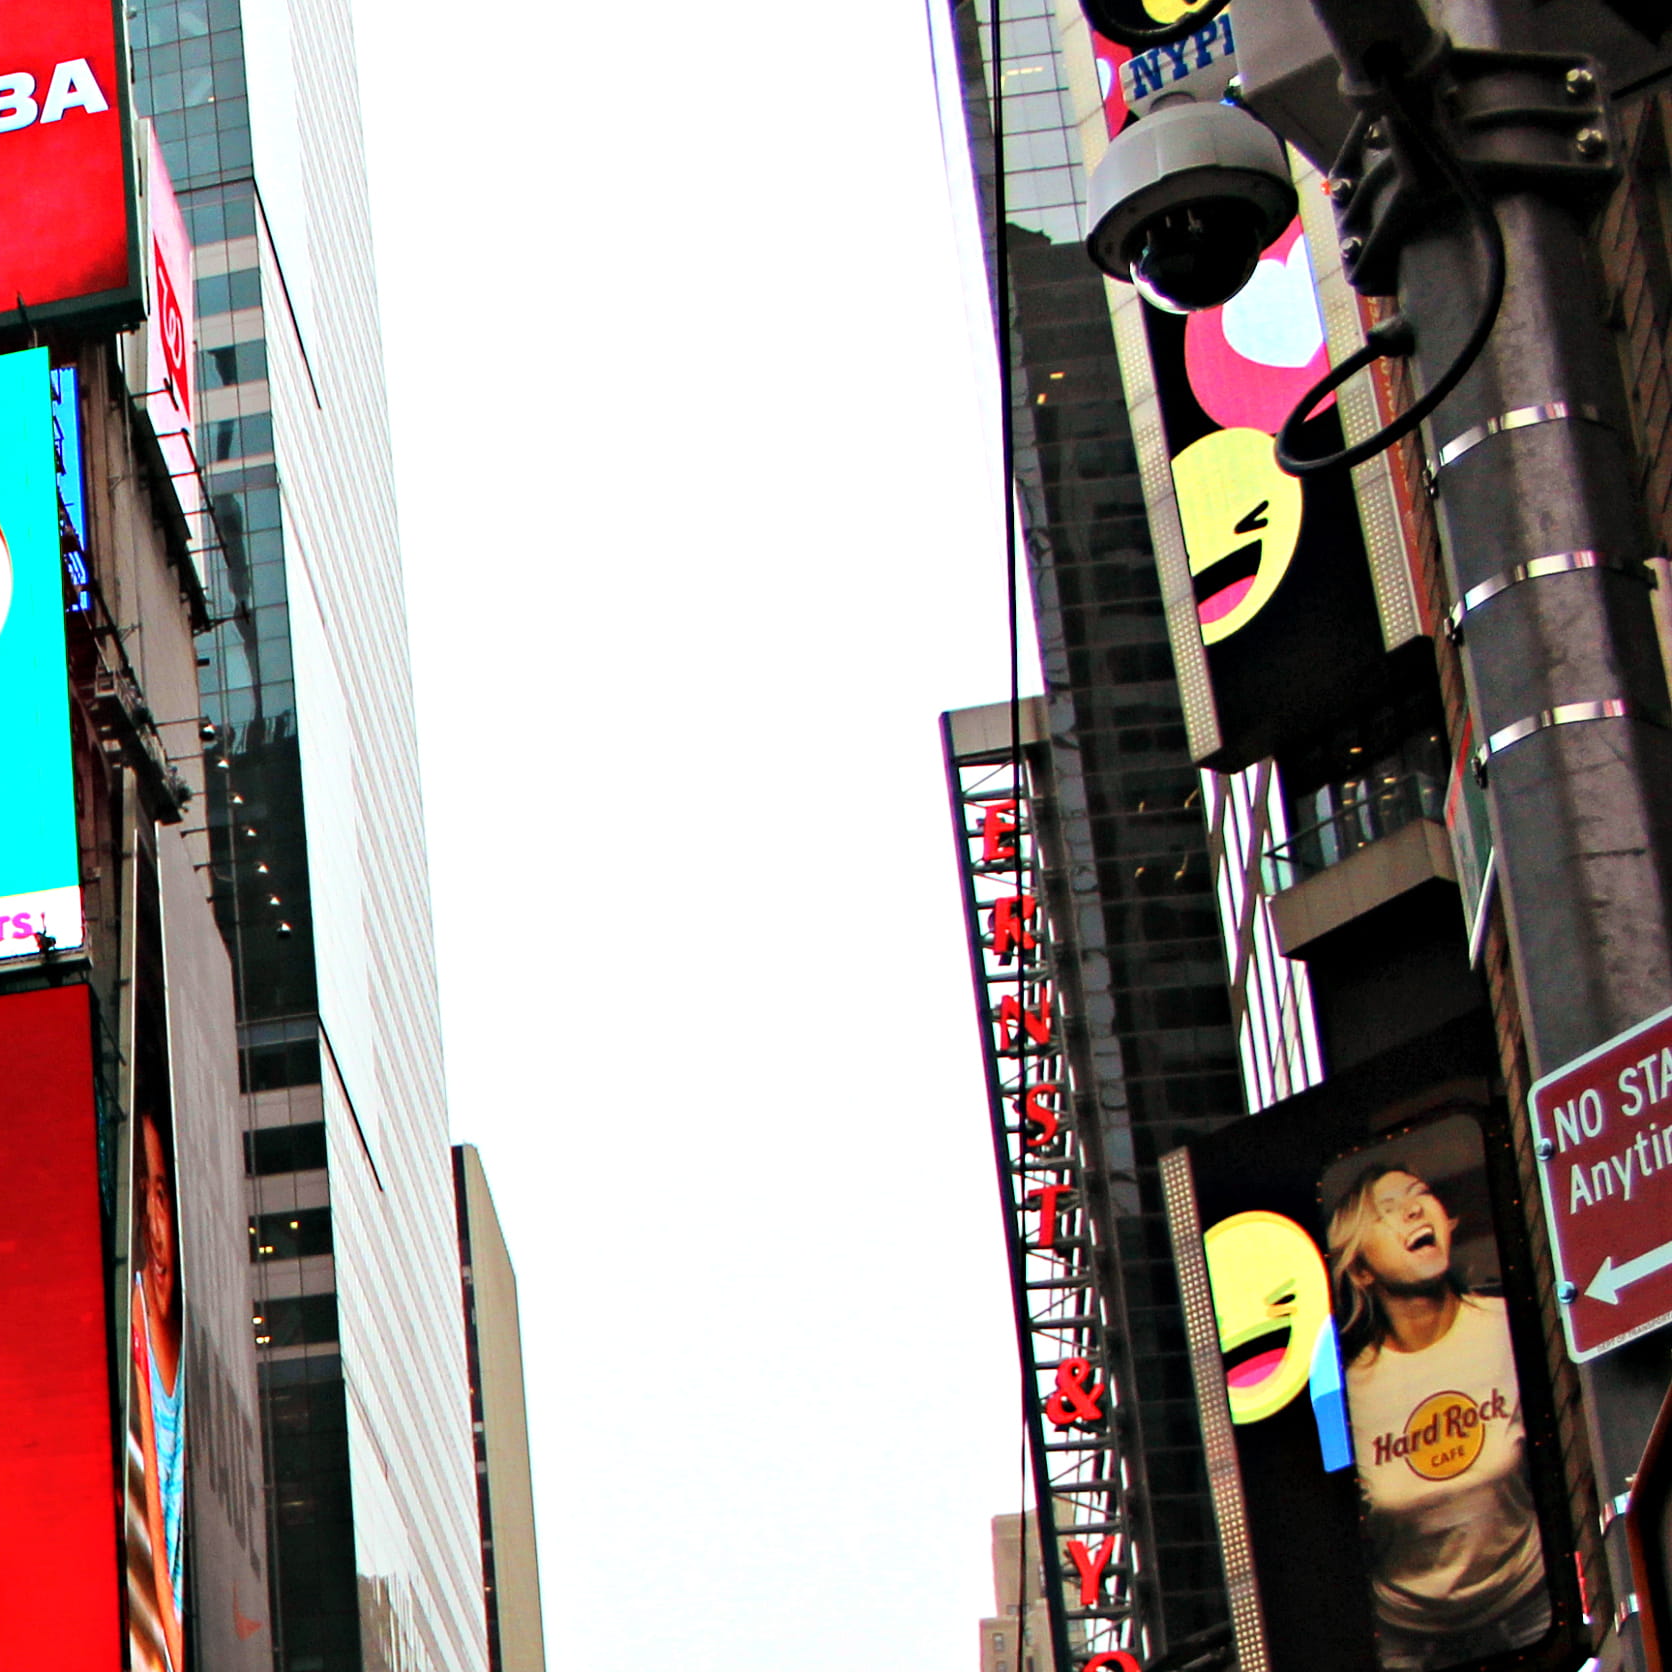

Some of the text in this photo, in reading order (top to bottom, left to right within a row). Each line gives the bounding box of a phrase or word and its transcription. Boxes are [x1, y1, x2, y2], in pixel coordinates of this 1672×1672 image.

[1552, 1088, 1604, 1154] NO
[1372, 1388, 1509, 1466] Hard Rock
[1429, 1443, 1467, 1469] CAFE
